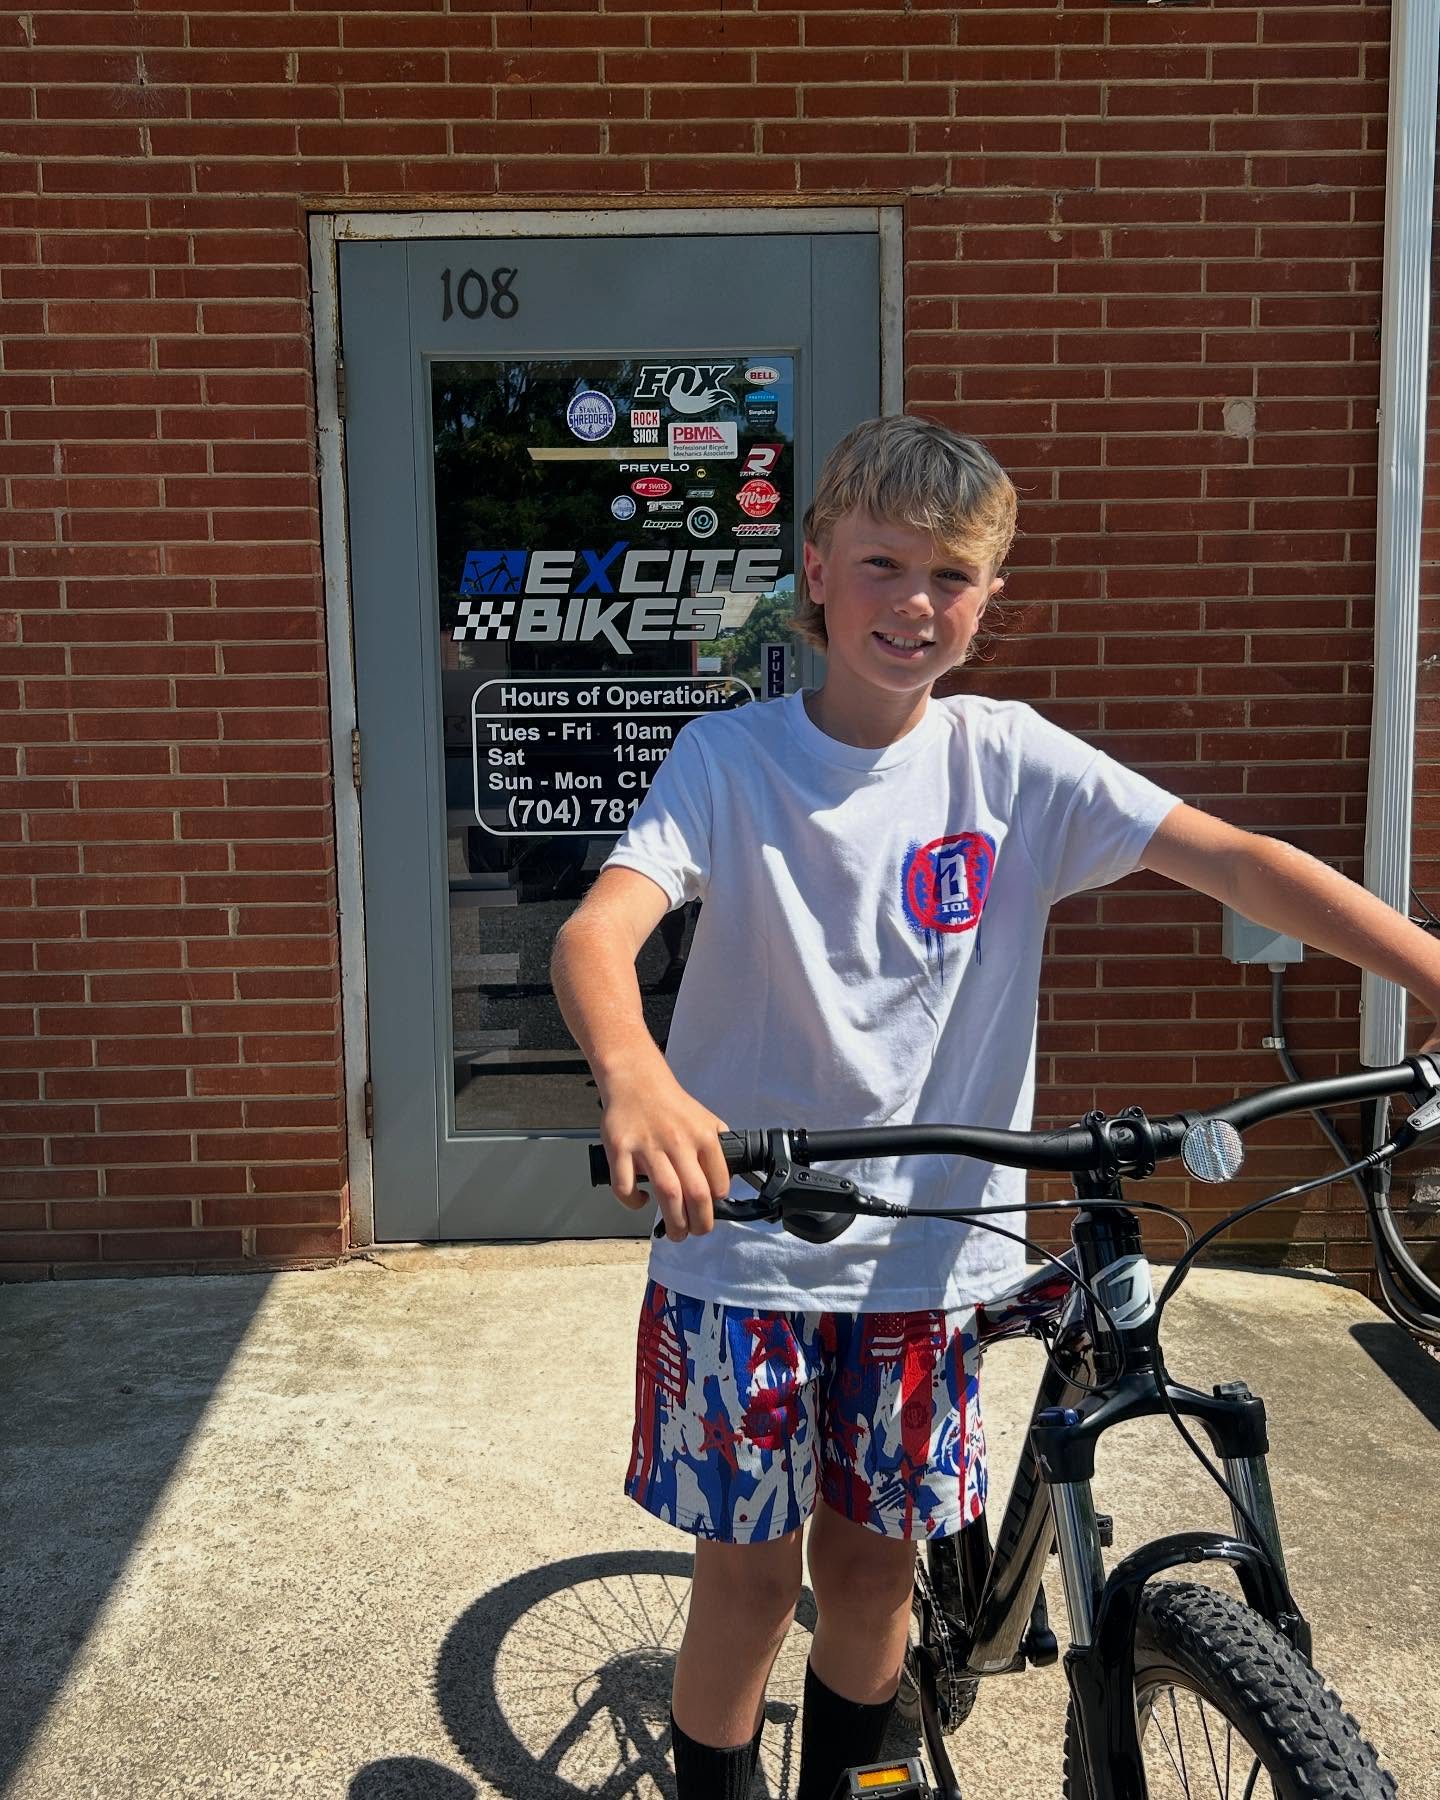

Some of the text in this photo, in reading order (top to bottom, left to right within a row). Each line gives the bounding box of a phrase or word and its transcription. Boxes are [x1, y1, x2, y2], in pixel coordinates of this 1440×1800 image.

[441, 267, 519, 321] 108
[750, 371, 775, 380] BELL
[634, 365, 736, 405] FOX
[579, 405, 601, 414] STANLY
[633, 411, 659, 426] ROCK
[568, 413, 614, 428] SHREDDERS
[633, 429, 659, 444] SHOX
[673, 426, 722, 441] PBMA
[709, 444, 729, 453] Bicycle
[619, 463, 690, 474] PREVELO
[736, 491, 780, 508] Nirve
[525, 541, 782, 593] EXCITE
[515, 597, 725, 655] BIKES
[772, 650, 781, 695] PULL
[501, 685, 727, 710] Hours of Operation:
[486, 723, 541, 741] Tues
[562, 722, 592, 740] Fri
[612, 721, 672, 740] 10am
[488, 744, 670, 766] Sat 11am
[488, 772, 533, 791] Sun
[555, 771, 602, 790] Mon
[508, 795, 581, 828] (704)
[941, 901, 969, 913] 101
